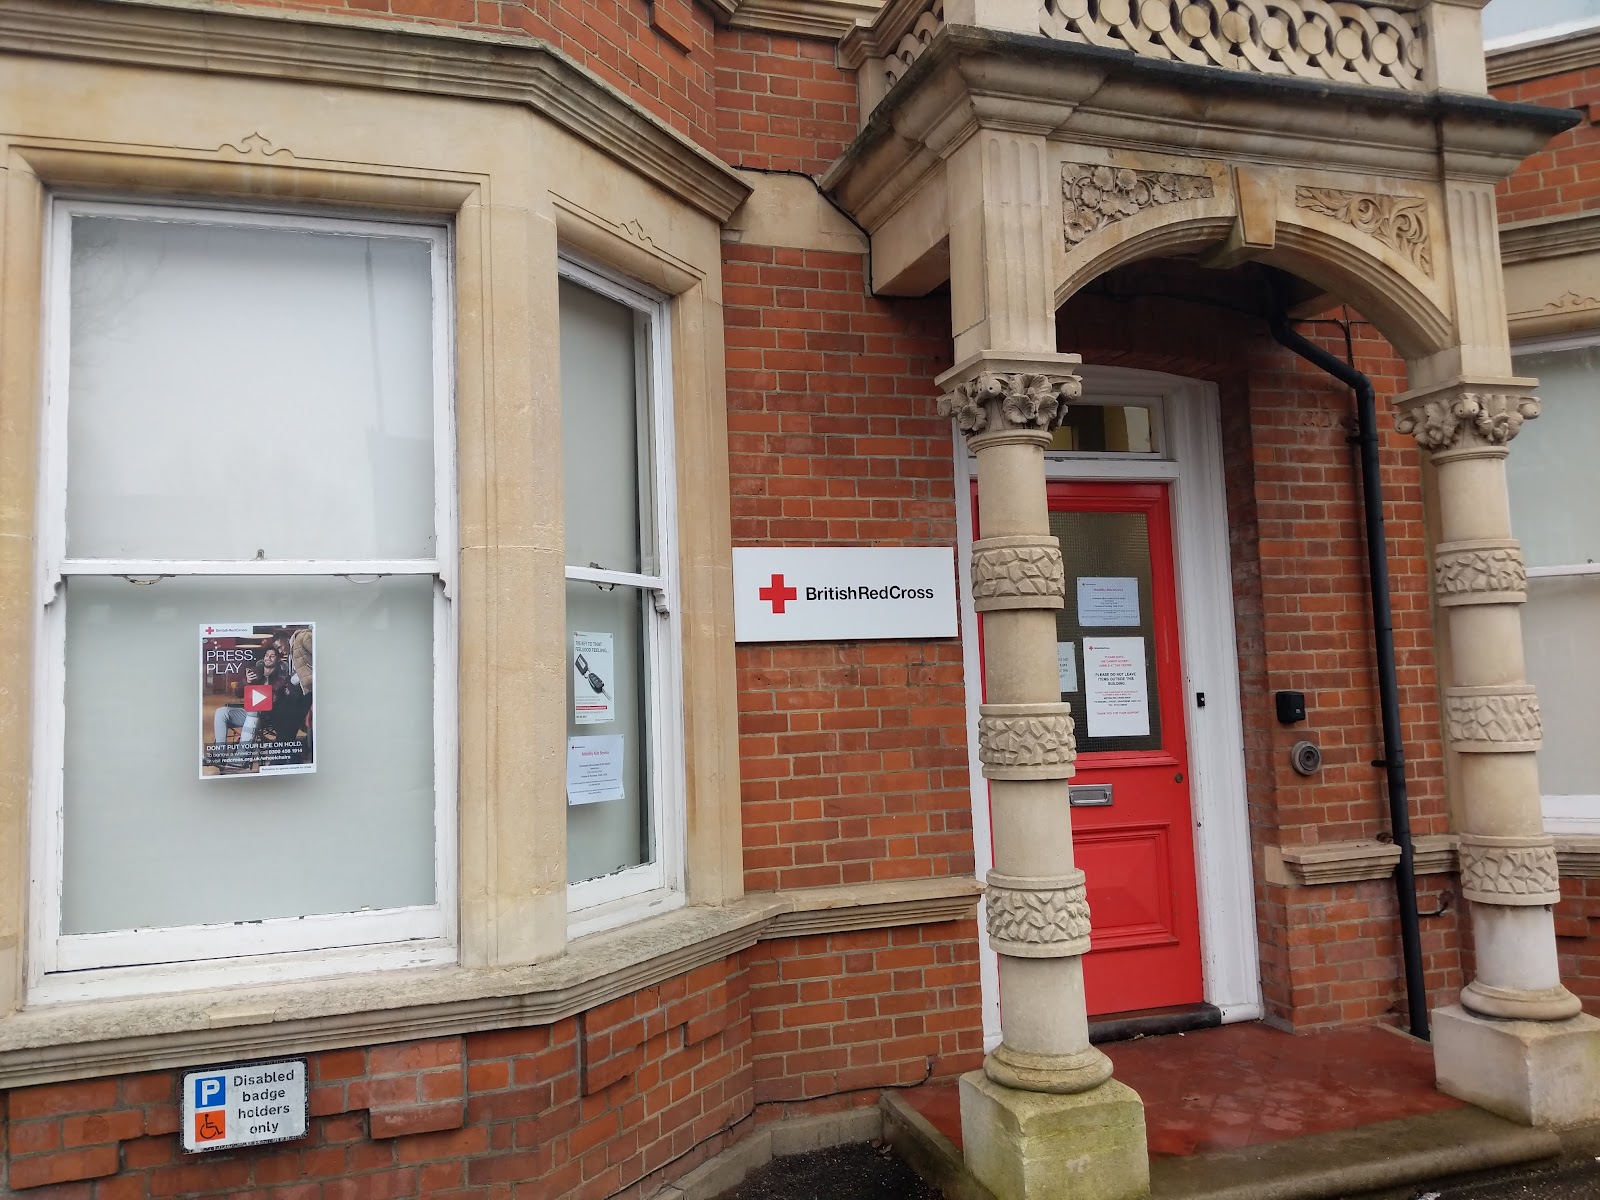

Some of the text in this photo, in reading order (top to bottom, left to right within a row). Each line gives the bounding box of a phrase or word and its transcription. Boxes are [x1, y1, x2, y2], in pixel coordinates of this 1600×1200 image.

[806, 585, 934, 601] BritishRedCross
[207, 650, 256, 662] PRESS.
[207, 663, 242, 674] PLAY
[234, 1070, 294, 1087] Disabled
[202, 1080, 220, 1106] P
[243, 1089, 286, 1102] badge
[238, 1105, 290, 1119] holders
[250, 1121, 279, 1134] only
